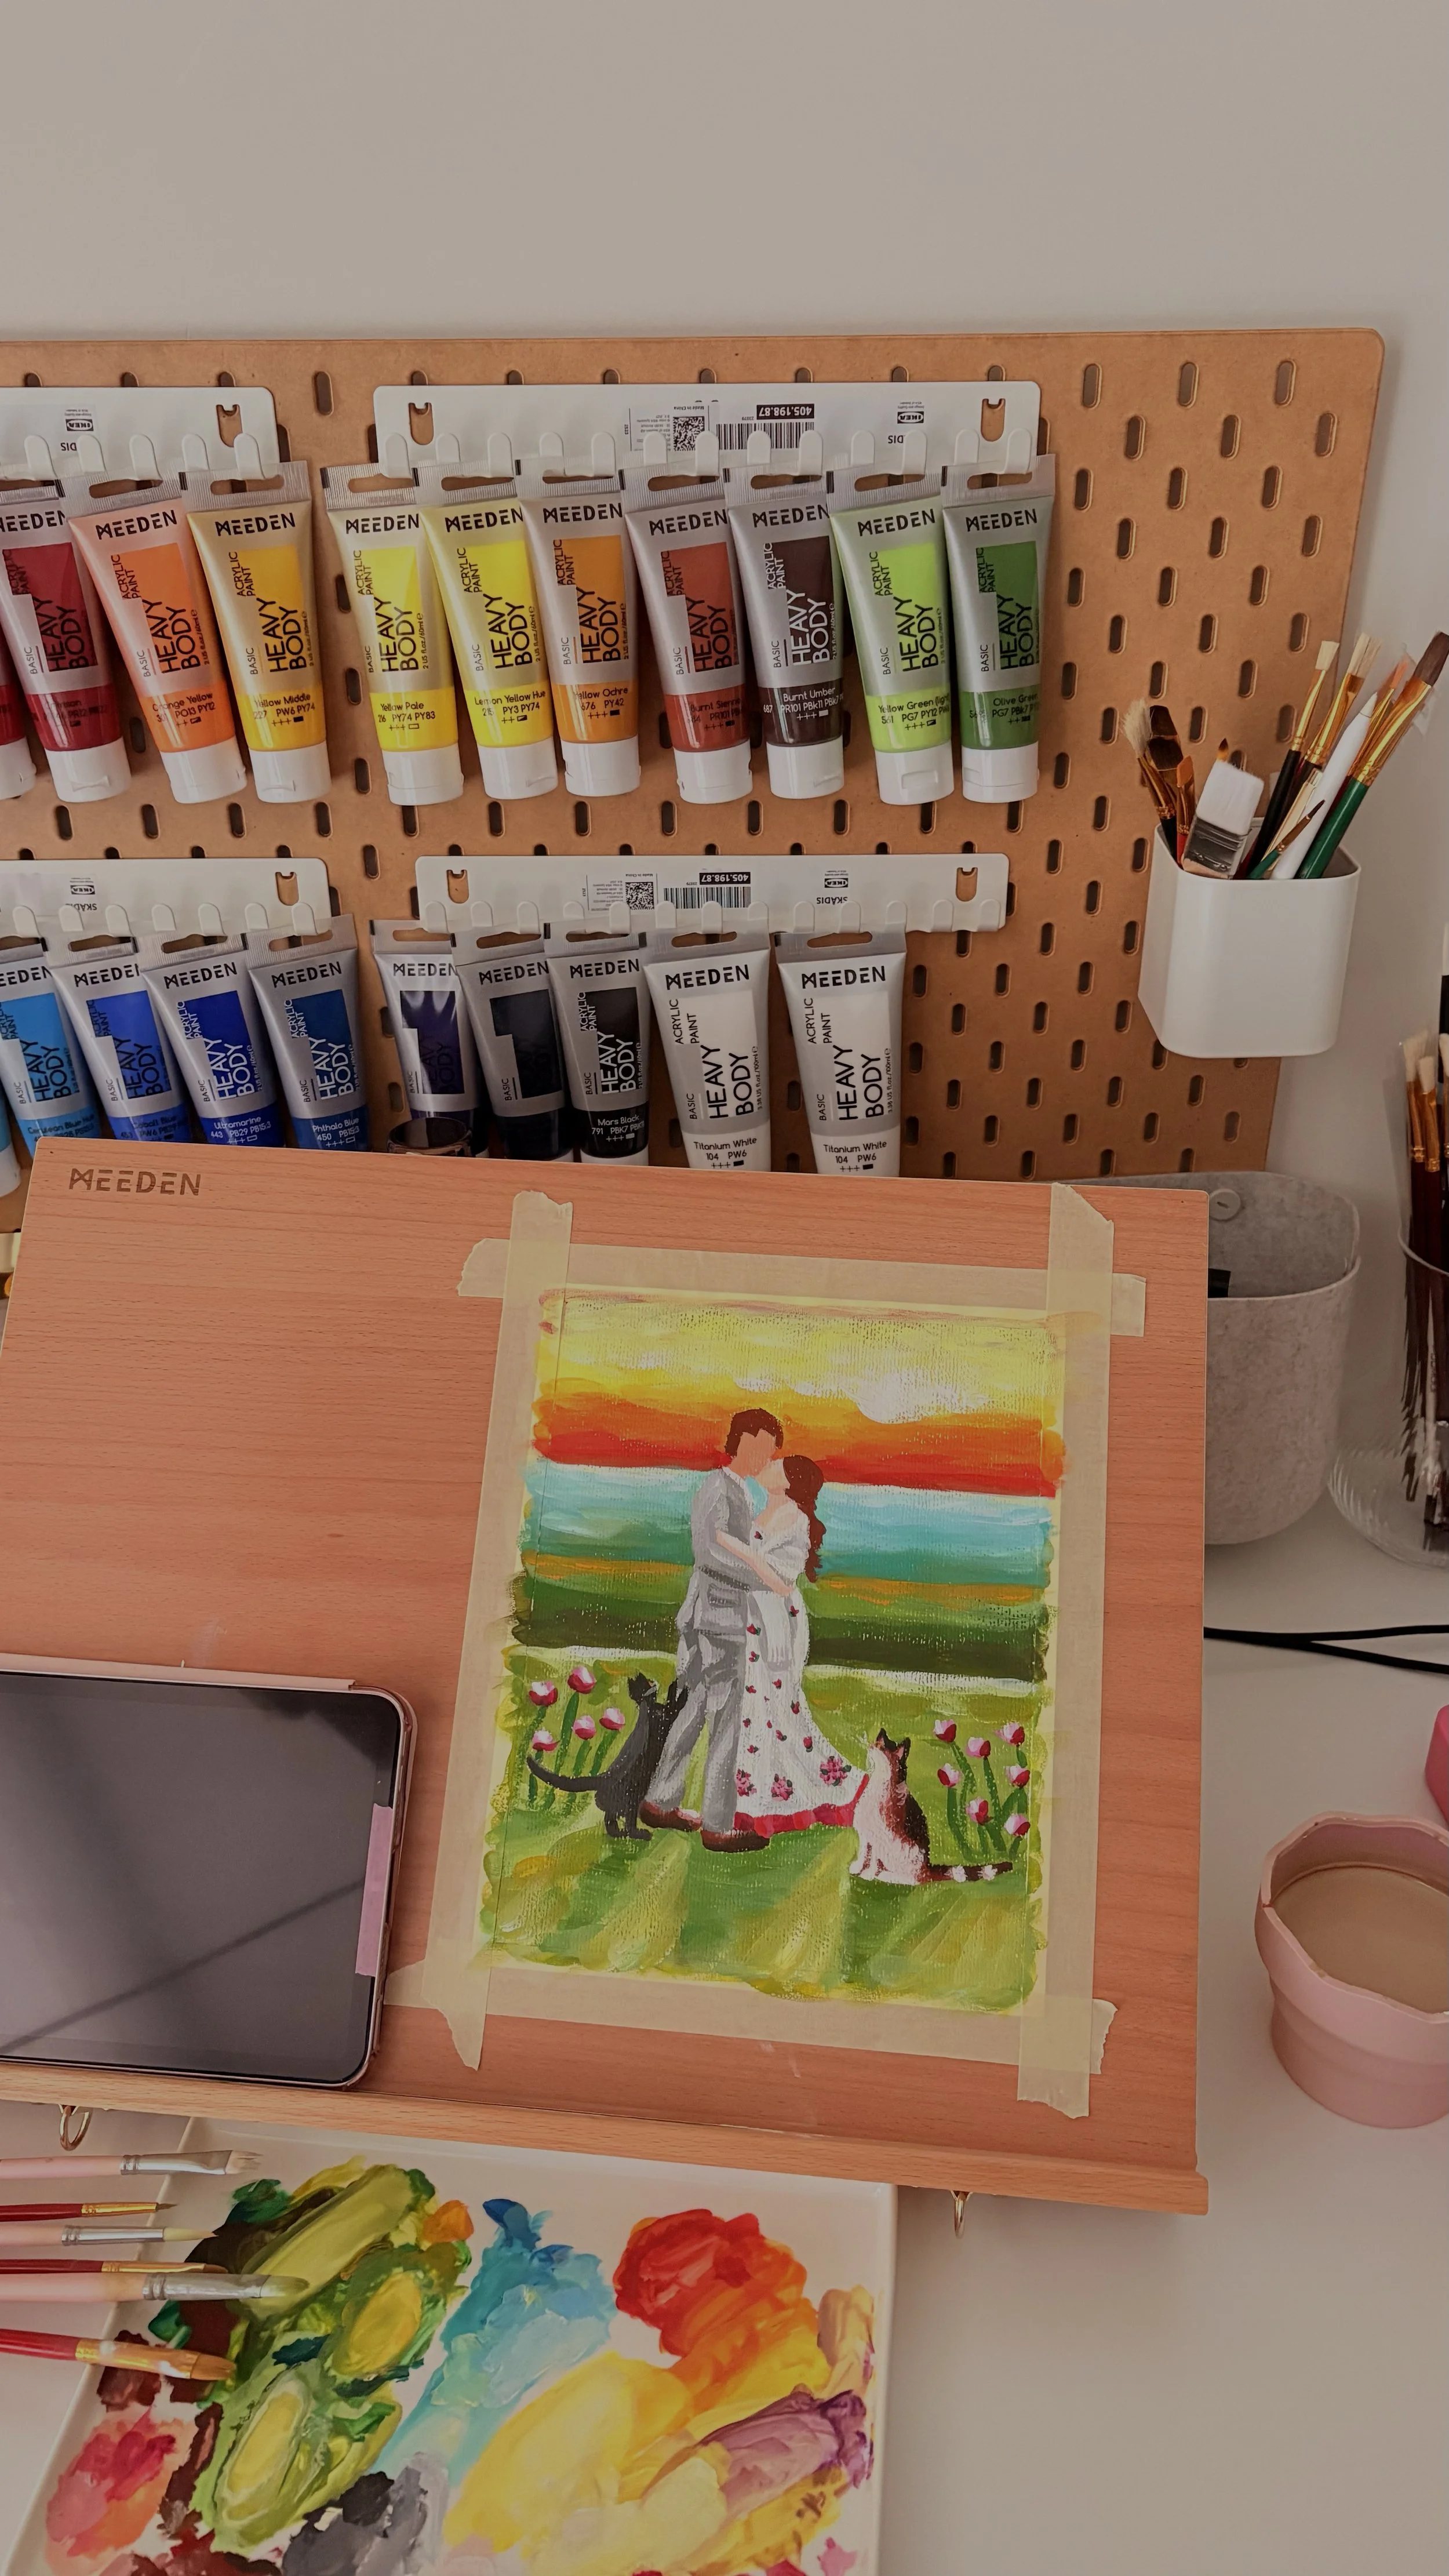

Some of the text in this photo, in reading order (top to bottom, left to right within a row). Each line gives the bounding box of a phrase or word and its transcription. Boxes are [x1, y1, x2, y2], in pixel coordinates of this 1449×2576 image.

[759, 406, 811, 417] 405.198.87
[96, 510, 177, 539] MEEDEN
[215, 512, 296, 536] MEEDEN
[346, 514, 419, 534] MEEDEN
[445, 508, 523, 533] MEEDEN
[543, 503, 623, 523] MEEDEN
[649, 509, 729, 536] MEEDEN
[752, 504, 829, 528] MEEDEN
[858, 508, 935, 537] MEEDEN
[966, 508, 1037, 532] MEEDEN
[354, 550, 365, 595] ACRYLIC
[363, 566, 374, 595] PAINT
[565, 555, 576, 585] PAINT
[775, 558, 786, 590] PAINT
[976, 548, 985, 593] ACRYLIC
[985, 563, 996, 592] PAINT
[56, 605, 89, 669] BODY
[143, 599, 181, 674] HEAVY
[166, 606, 201, 669] BODY
[256, 598, 289, 672] HEAVY
[279, 606, 307, 670] BODY
[373, 597, 399, 672] HEAVY
[394, 607, 418, 671] BODY
[483, 594, 514, 669] HEAVY
[505, 602, 533, 666] BODY
[576, 587, 602, 664] HEAVY
[598, 597, 621, 662] BODY
[685, 596, 715, 672] HEAVY
[707, 605, 732, 670] BODY
[785, 589, 812, 666] HEAVY
[807, 598, 831, 664] BODY
[893, 596, 920, 672] HEAVY
[915, 603, 938, 668] BODY
[996, 594, 1018, 670] HEAVY
[1015, 602, 1033, 667] BODY
[246, 647, 258, 675] BASIC
[363, 646, 374, 673] BASIC
[423, 654, 428, 664] US
[470, 644, 483, 671] BASIC
[563, 637, 571, 665] BASIC
[672, 647, 684, 675] BASIC
[773, 641, 781, 668] BASIC
[880, 647, 891, 675] BASIC
[187, 693, 212, 704] Yellow
[283, 693, 311, 704] Middle
[475, 691, 545, 705] Lemon Yellow Hue
[581, 698, 624, 711] 676 PY42
[603, 687, 628, 697] Ochre
[783, 691, 807, 702] Burnt
[810, 687, 835, 698] Umber
[993, 697, 1016, 706] Olive
[276, 703, 315, 716] PW6 PY74
[381, 701, 424, 711] Yellow Pale
[392, 711, 435, 722] PY74 PY83
[503, 702, 540, 715] PY3 PY74
[690, 702, 713, 712] Burnt
[763, 705, 773, 713] 687
[780, 704, 801, 713] PR101
[803, 700, 823, 711] PBk11
[878, 700, 934, 713] Yellow Green
[882, 716, 893, 724] 561
[902, 712, 918, 722] PG7
[992, 708, 1009, 717] PG7
[701, 874, 748, 883] 405.198.87
[65, 903, 97, 911] SKÅD
[817, 897, 847, 905] SKÅDIS
[164, 962, 237, 989] MEEDEN
[271, 961, 342, 988] MEEDEN
[393, 963, 458, 976] MEEDEN
[479, 960, 549, 985] MEEDEN
[570, 959, 639, 978] MEEDEN
[665, 965, 749, 990] MEEDEN
[802, 966, 886, 989] MEEDEN
[578, 992, 589, 1031] ACRYLIC
[588, 1005, 596, 1031] PAINT
[821, 1013, 833, 1043] PAINT
[20, 1039, 53, 1101] HEAVY
[41, 1046, 71, 1099] BODY
[112, 1037, 143, 1098] HEAVY
[134, 1043, 163, 1096] BODY
[203, 1038, 236, 1100] HEAVY
[224, 1043, 255, 1096] BODY
[308, 1037, 338, 1100] HEAVY
[328, 1043, 354, 1096] BODY
[597, 1031, 620, 1094] HEAVY
[616, 1039, 636, 1093] BODY
[106, 1079, 118, 1101] BASIC
[198, 1080, 210, 1102] BASIC
[301, 1080, 311, 1103] BASIC
[503, 1078, 512, 1101] BASIC
[700, 1045, 729, 1118] HEAVY
[729, 1053, 753, 1115] BODY
[757, 1089, 762, 1097] US
[833, 1045, 858, 1120] HEAVY
[861, 1054, 884, 1118] BODY
[687, 1093, 697, 1119] BASIC
[65, 1119, 81, 1129] Blue
[161, 1116, 177, 1124] Blue
[214, 1116, 261, 1130] Ultramarine
[230, 1127, 248, 1136] PB29
[312, 1118, 359, 1133] Phthalo Blue
[598, 1115, 639, 1126] Mars Black
[317, 1133, 332, 1141] 450
[694, 1137, 757, 1151] Titanium White
[824, 1141, 887, 1152] Titanium White
[728, 1150, 747, 1159] PW6
[858, 1154, 877, 1163] PW6
[68, 1168, 201, 1196] MEEDEN
